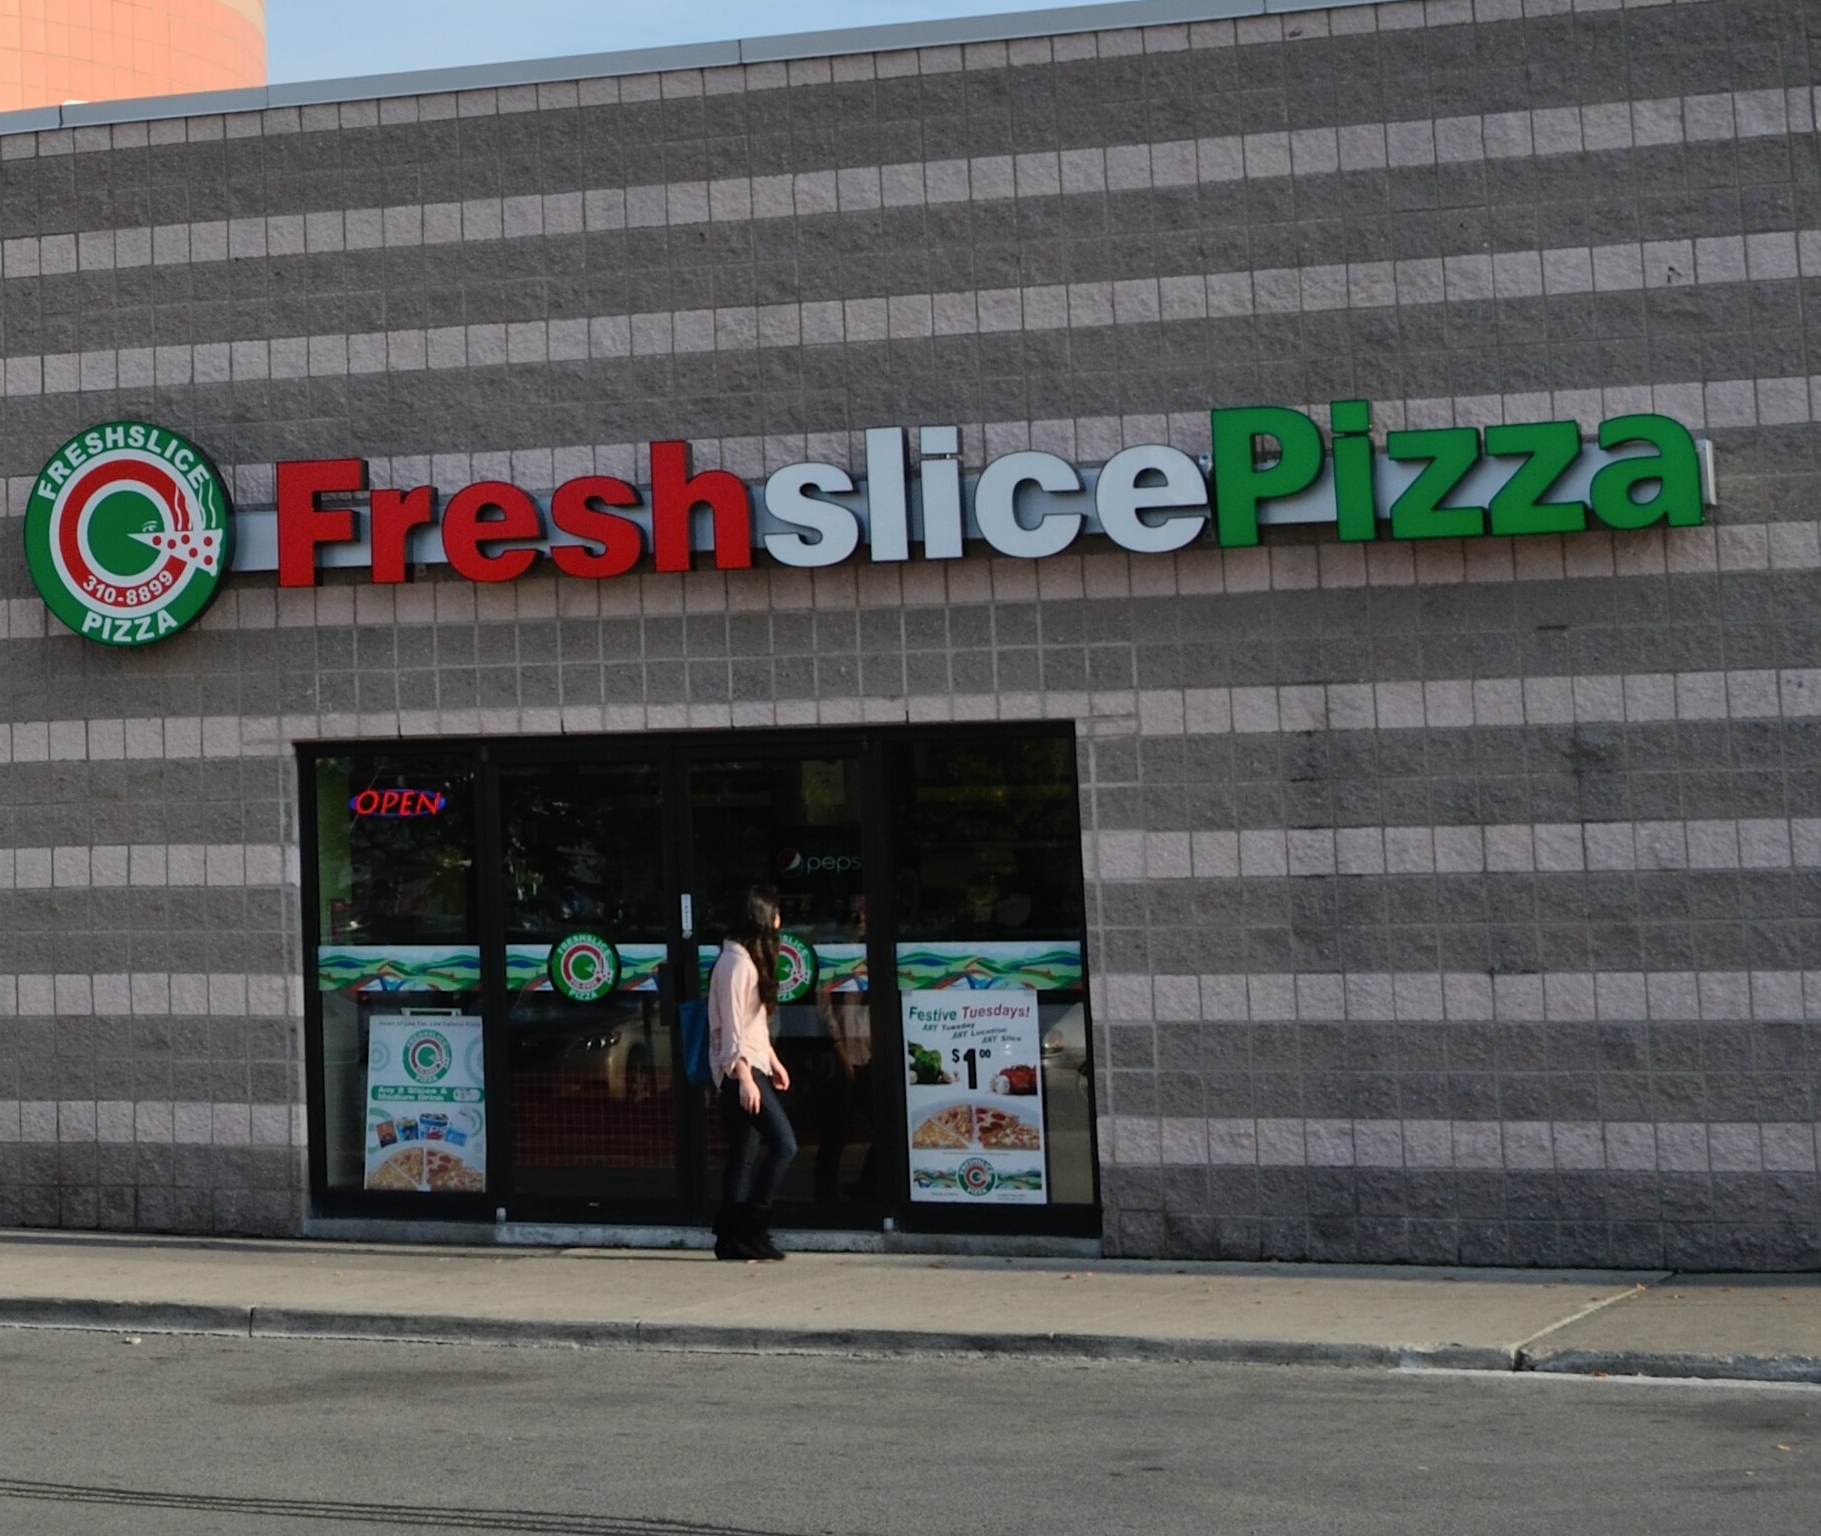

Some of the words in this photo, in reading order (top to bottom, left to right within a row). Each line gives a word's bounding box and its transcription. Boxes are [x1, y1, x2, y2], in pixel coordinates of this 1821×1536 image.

[37, 425, 211, 501] FRESHSLICE
[82, 570, 173, 606] 310-8899
[81, 608, 178, 643] PIZZA
[355, 789, 442, 816] OPEN
[807, 856, 861, 874] peps
[569, 989, 598, 1000] PIZZA
[909, 1006, 957, 1021] Festive
[962, 1004, 1030, 1019] Tuesdays!
[942, 1022, 975, 1031] Tuesday
[952, 1031, 968, 1039] ANY
[971, 1028, 1007, 1037] Location
[981, 1035, 998, 1043] ANY
